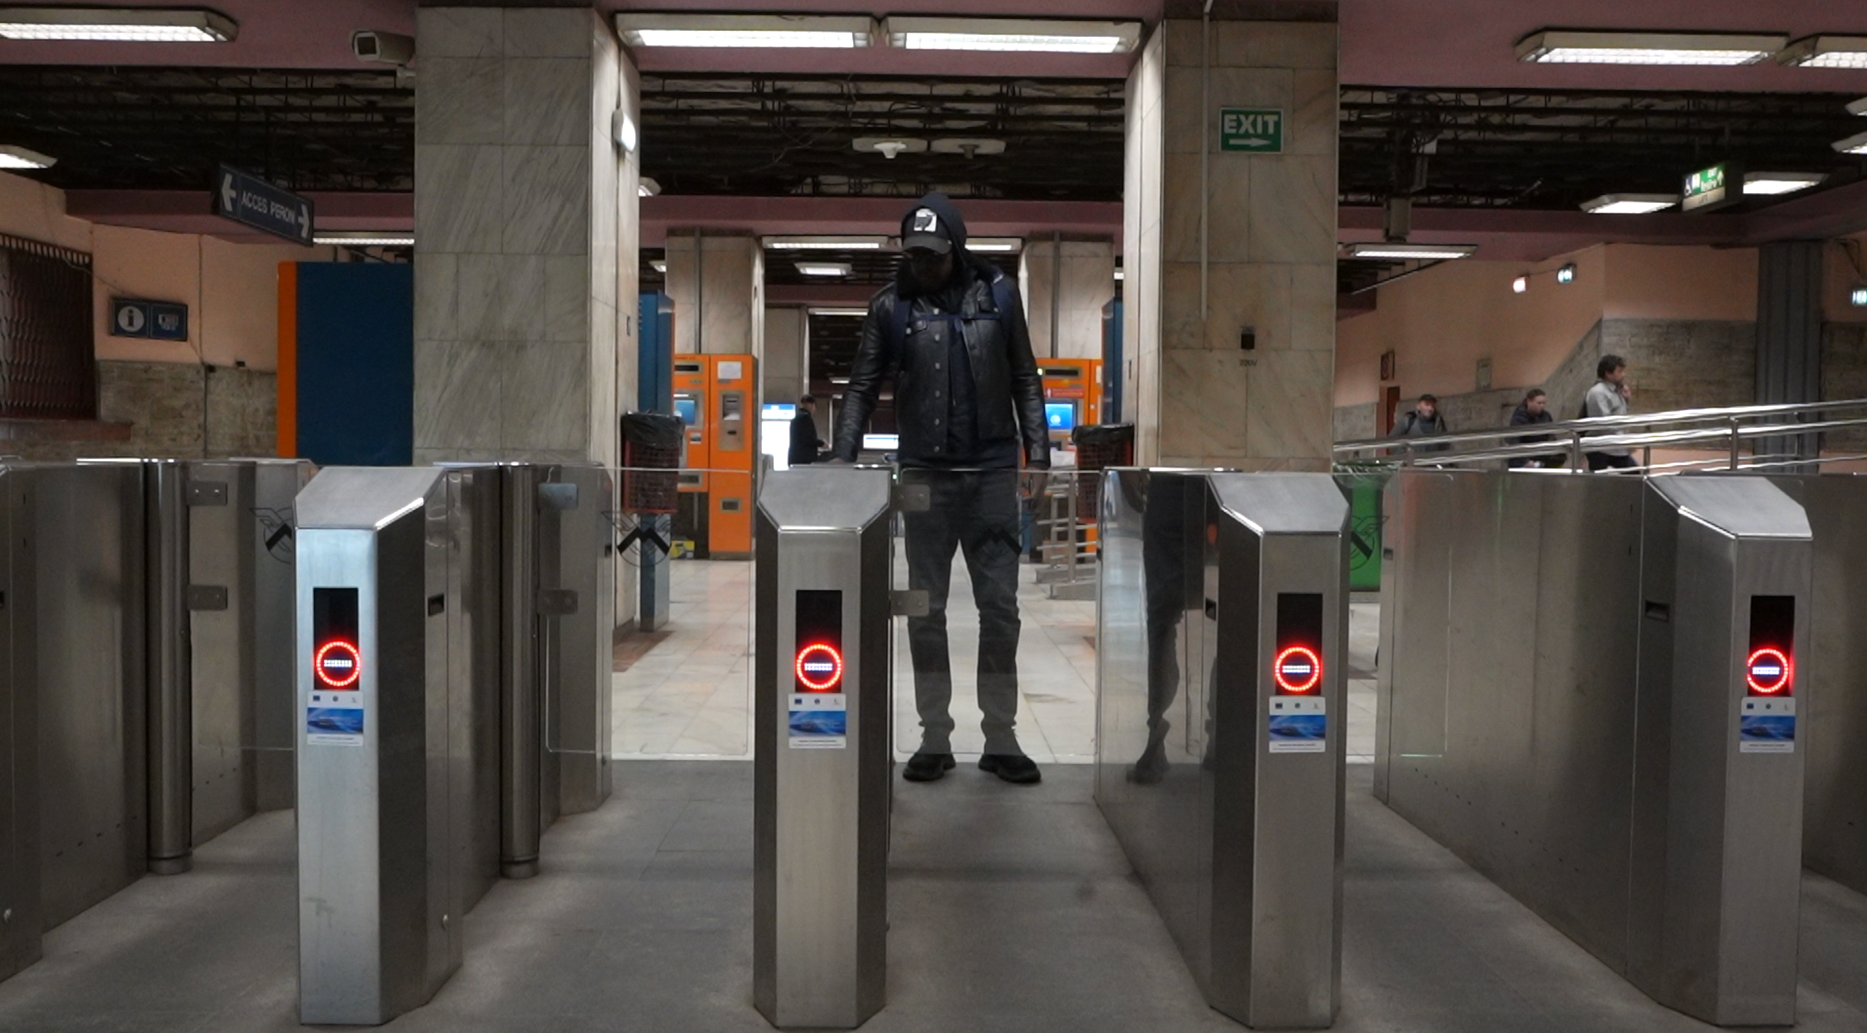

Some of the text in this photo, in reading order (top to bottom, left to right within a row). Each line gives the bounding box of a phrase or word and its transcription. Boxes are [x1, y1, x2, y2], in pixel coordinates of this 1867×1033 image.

[1223, 114, 1279, 135] EXIT
[241, 190, 296, 225] ACCES PERON
